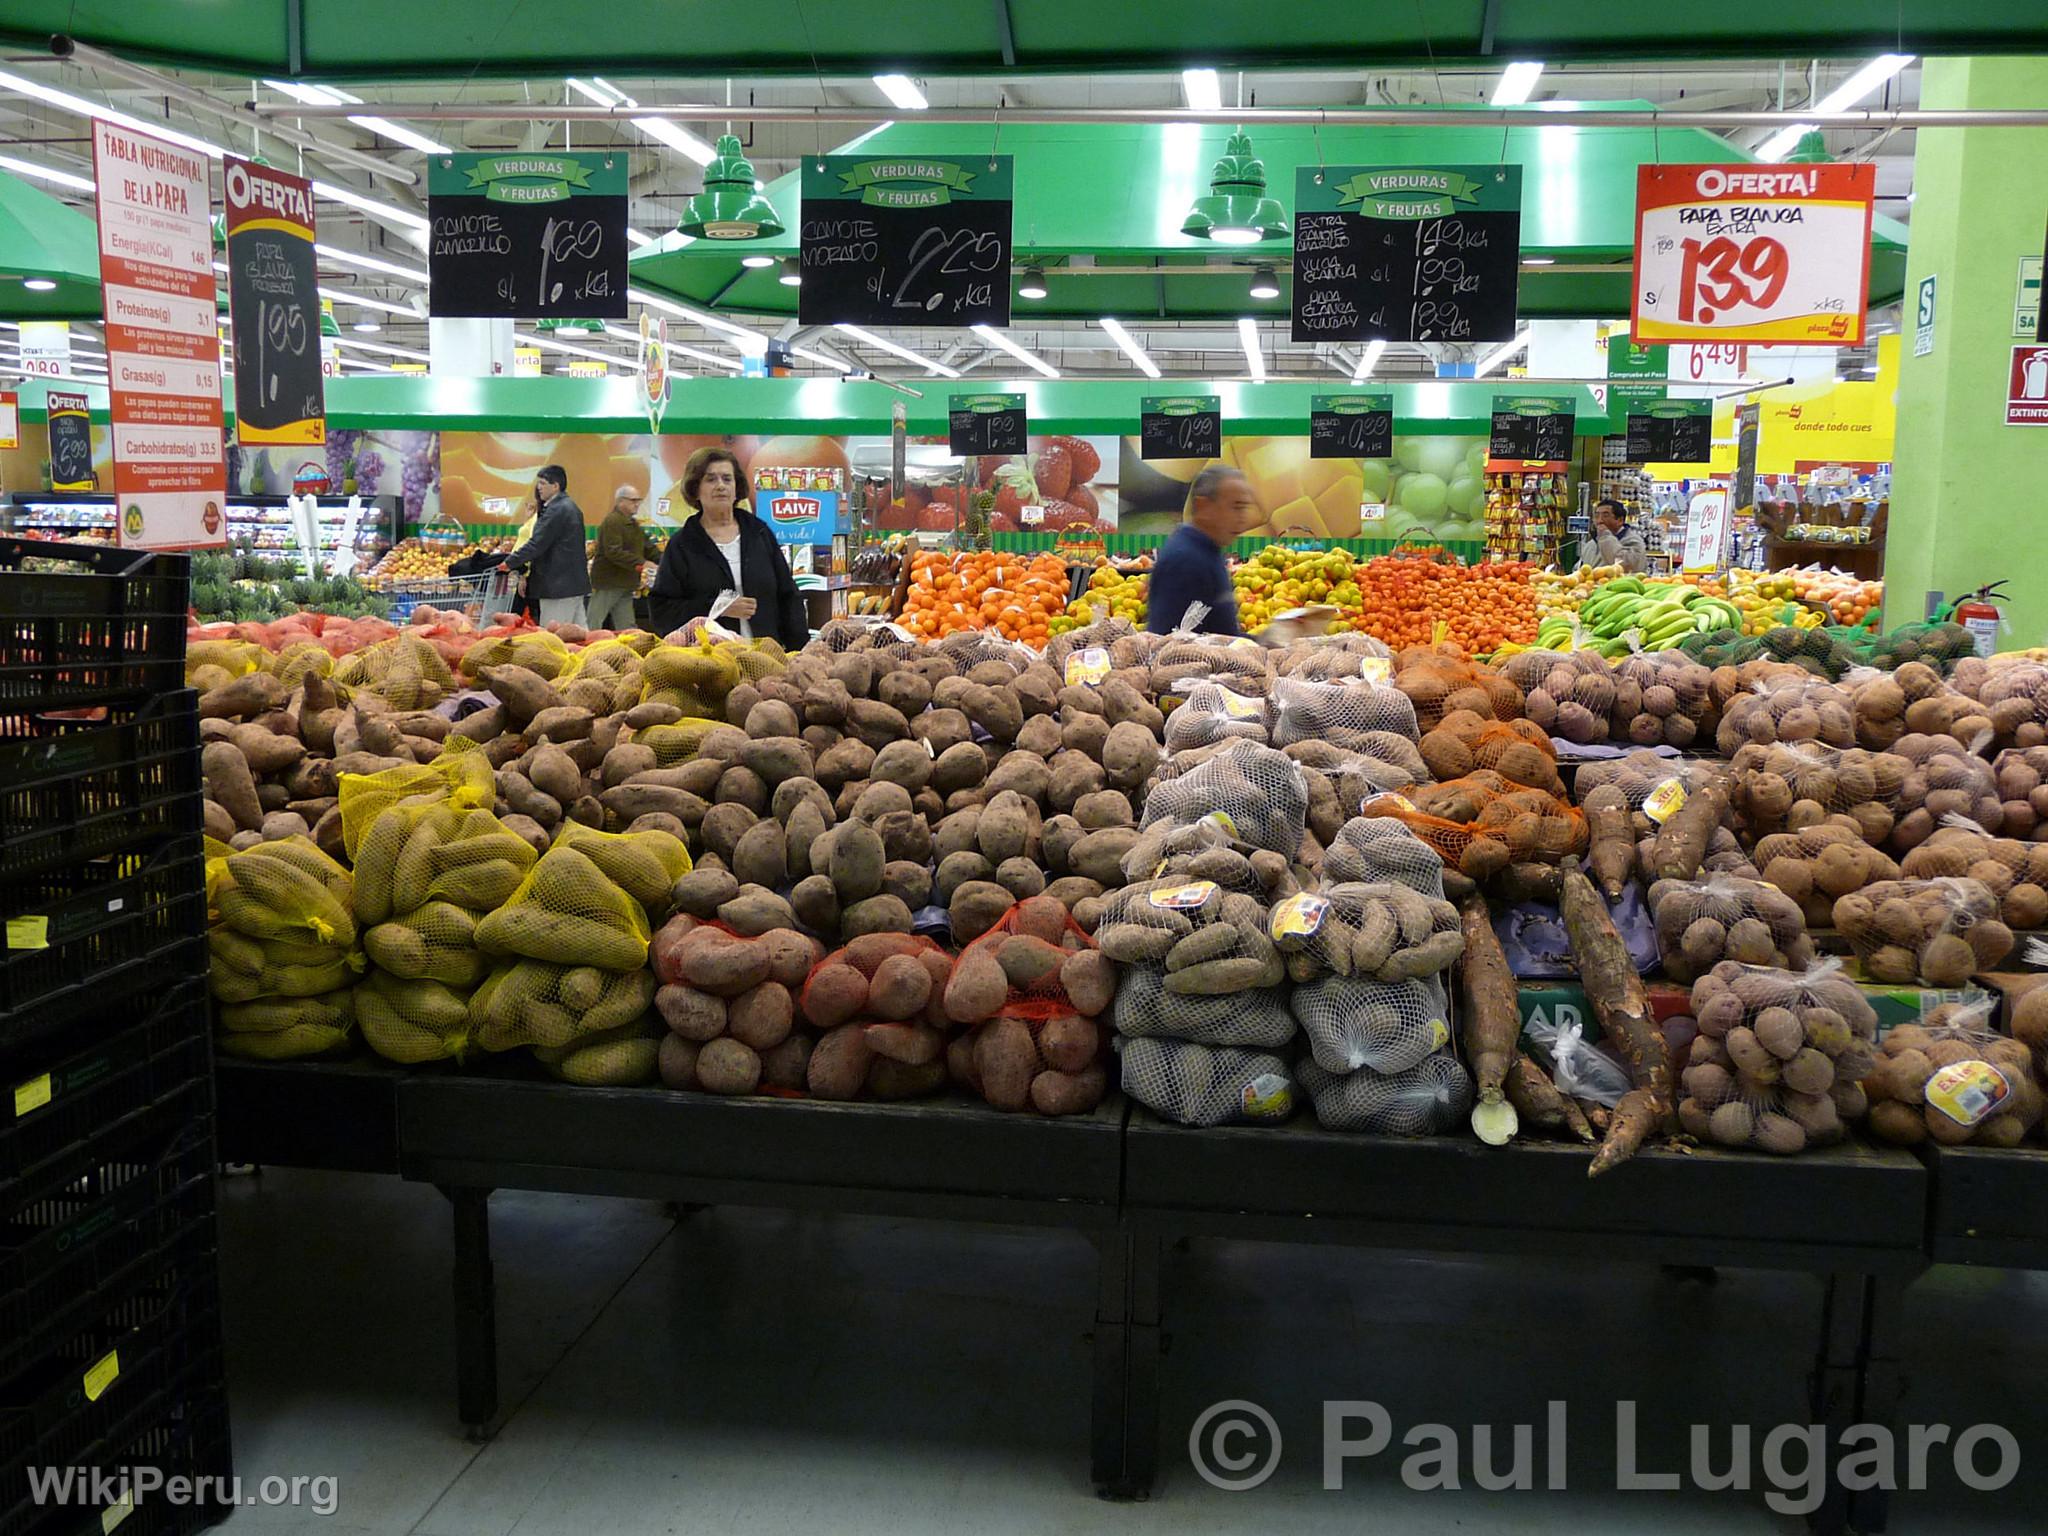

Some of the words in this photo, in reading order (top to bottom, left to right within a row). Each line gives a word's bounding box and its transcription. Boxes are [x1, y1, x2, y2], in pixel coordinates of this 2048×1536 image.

[104, 133, 138, 164] TABLA
[141, 145, 203, 184] NUTRICIONAL
[494, 161, 564, 174] VERDURAS
[870, 165, 944, 178] VERDURAS
[1369, 175, 1448, 189] VERDURAS
[124, 179, 137, 202] DE
[141, 183, 152, 206] LA
[155, 181, 188, 215] PAPA
[500, 188, 508, 198] Y
[512, 187, 558, 199] FRUTAS
[877, 192, 886, 203] Y
[889, 192, 938, 204] FRUTAS
[1376, 203, 1386, 214] Y
[1389, 203, 1441, 216] FRUTAS
[1679, 207, 1723, 224] PAPA
[1730, 207, 1804, 224] BLANCA
[433, 215, 502, 236] CAMOTE
[801, 220, 878, 241] CAMOTE
[1299, 215, 1347, 230] EXTRA
[1706, 222, 1757, 236] EXTRA
[435, 235, 511, 255] AMARILLO
[1919, 282, 1933, 325] S
[122, 367, 166, 387] Grasas(g)
[126, 440, 197, 457] Carbohidratos(g)
[775, 502, 816, 515] LAIVE
